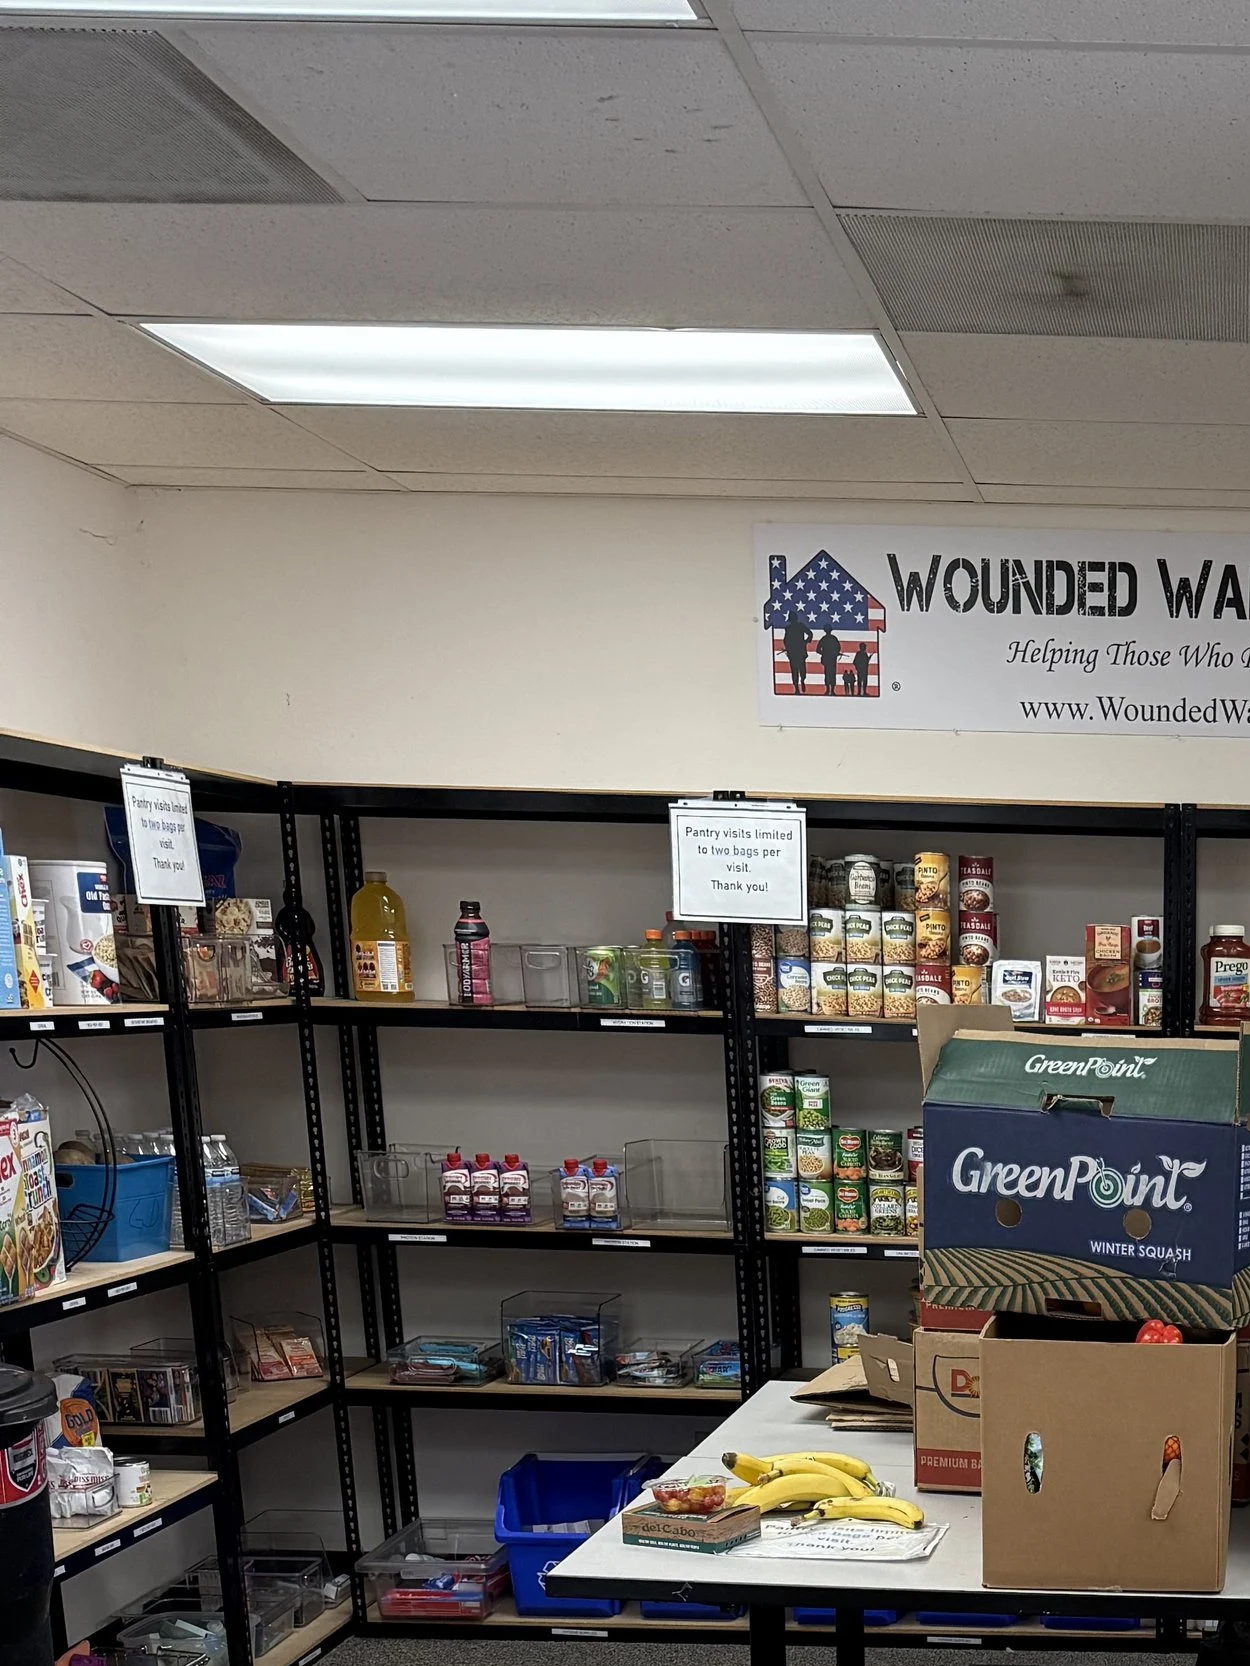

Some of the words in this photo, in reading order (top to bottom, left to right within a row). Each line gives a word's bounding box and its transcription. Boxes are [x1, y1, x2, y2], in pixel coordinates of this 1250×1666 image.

[886, 553, 1137, 618] WOUNDED
[1006, 640, 1099, 674] Helping
[1104, 642, 1171, 672] Those
[1178, 644, 1234, 671] Who
[132, 796, 152, 812] Pantry
[154, 799, 171, 812] visits
[171, 802, 188, 815] limited
[141, 818, 148, 829] to
[149, 820, 160, 830] two
[161, 820, 177, 834] bags
[177, 824, 185, 834] per
[685, 827, 720, 840] Pantry
[723, 828, 751, 839] visits
[755, 829, 793, 841] limited
[159, 838, 174, 850] visit.
[698, 845, 708, 855] to
[711, 845, 730, 855] two
[733, 845, 759, 858] bags
[763, 848, 781, 858] per
[153, 857, 171, 871] Thank
[173, 861, 185, 873] you!
[726, 862, 751, 873] visit.
[918, 866, 937, 874] PINTO
[961, 867, 991, 875] TEASDALE
[711, 880, 743, 891] Thank
[746, 881, 768, 893] you!
[961, 922, 991, 930] TEASDALE
[1215, 960, 1248, 975] Prego
[1052, 975, 1080, 983] KETO
[1024, 1054, 1157, 1078] GreenPoint
[952, 1147, 1207, 1210] GreenPoint
[1091, 1240, 1136, 1257] WINTER
[1139, 1242, 1192, 1261] SQUASH
[65, 1408, 93, 1428] GOLD
[921, 1456, 968, 1469] PREMIUM
